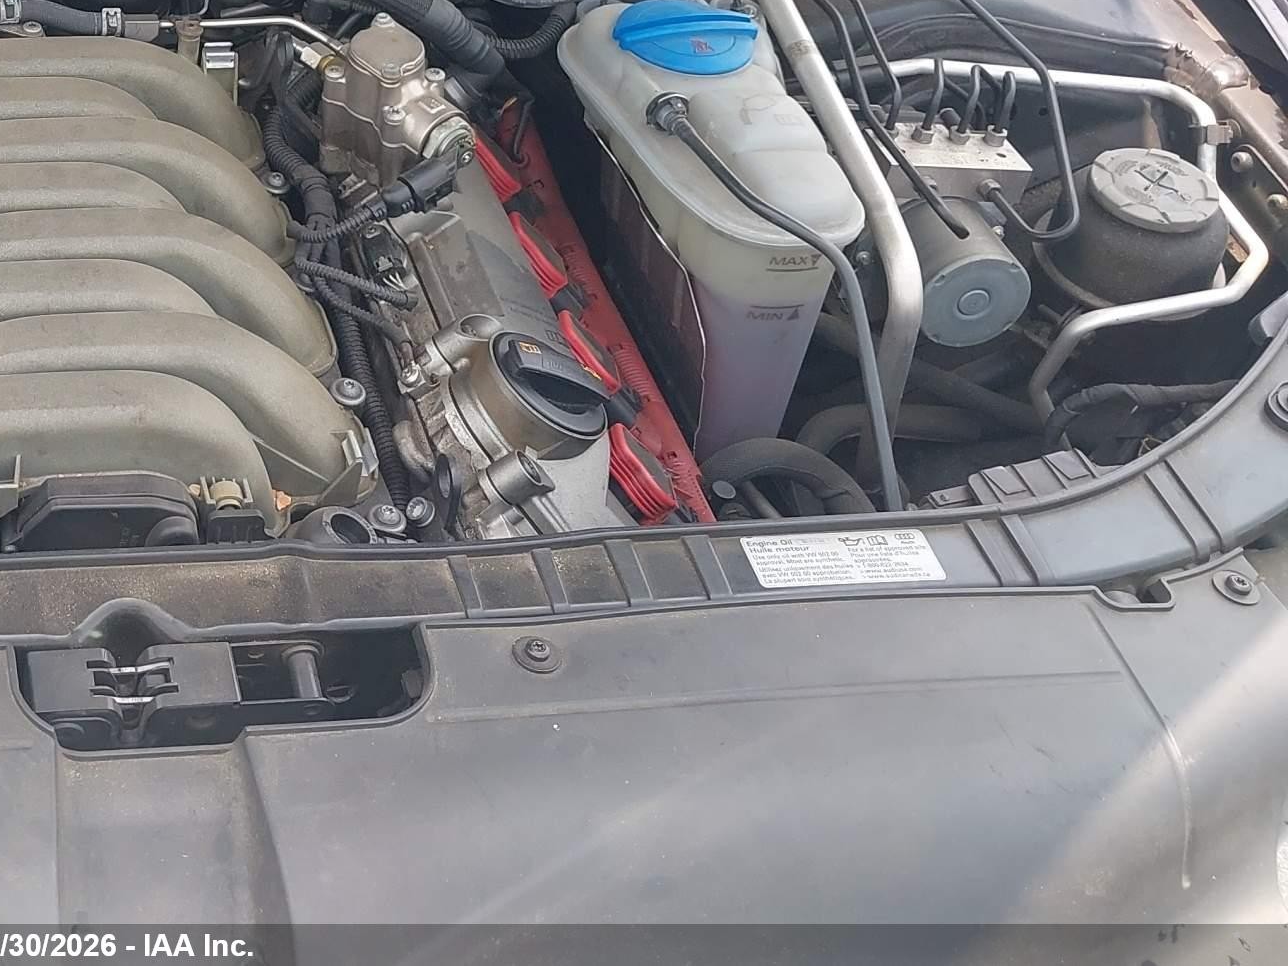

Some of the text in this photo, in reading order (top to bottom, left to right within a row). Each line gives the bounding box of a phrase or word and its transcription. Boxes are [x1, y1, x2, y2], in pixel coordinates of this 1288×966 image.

[769, 256, 808, 266] MAX
[746, 310, 783, 321] MIN
[746, 540, 778, 548] Engine
